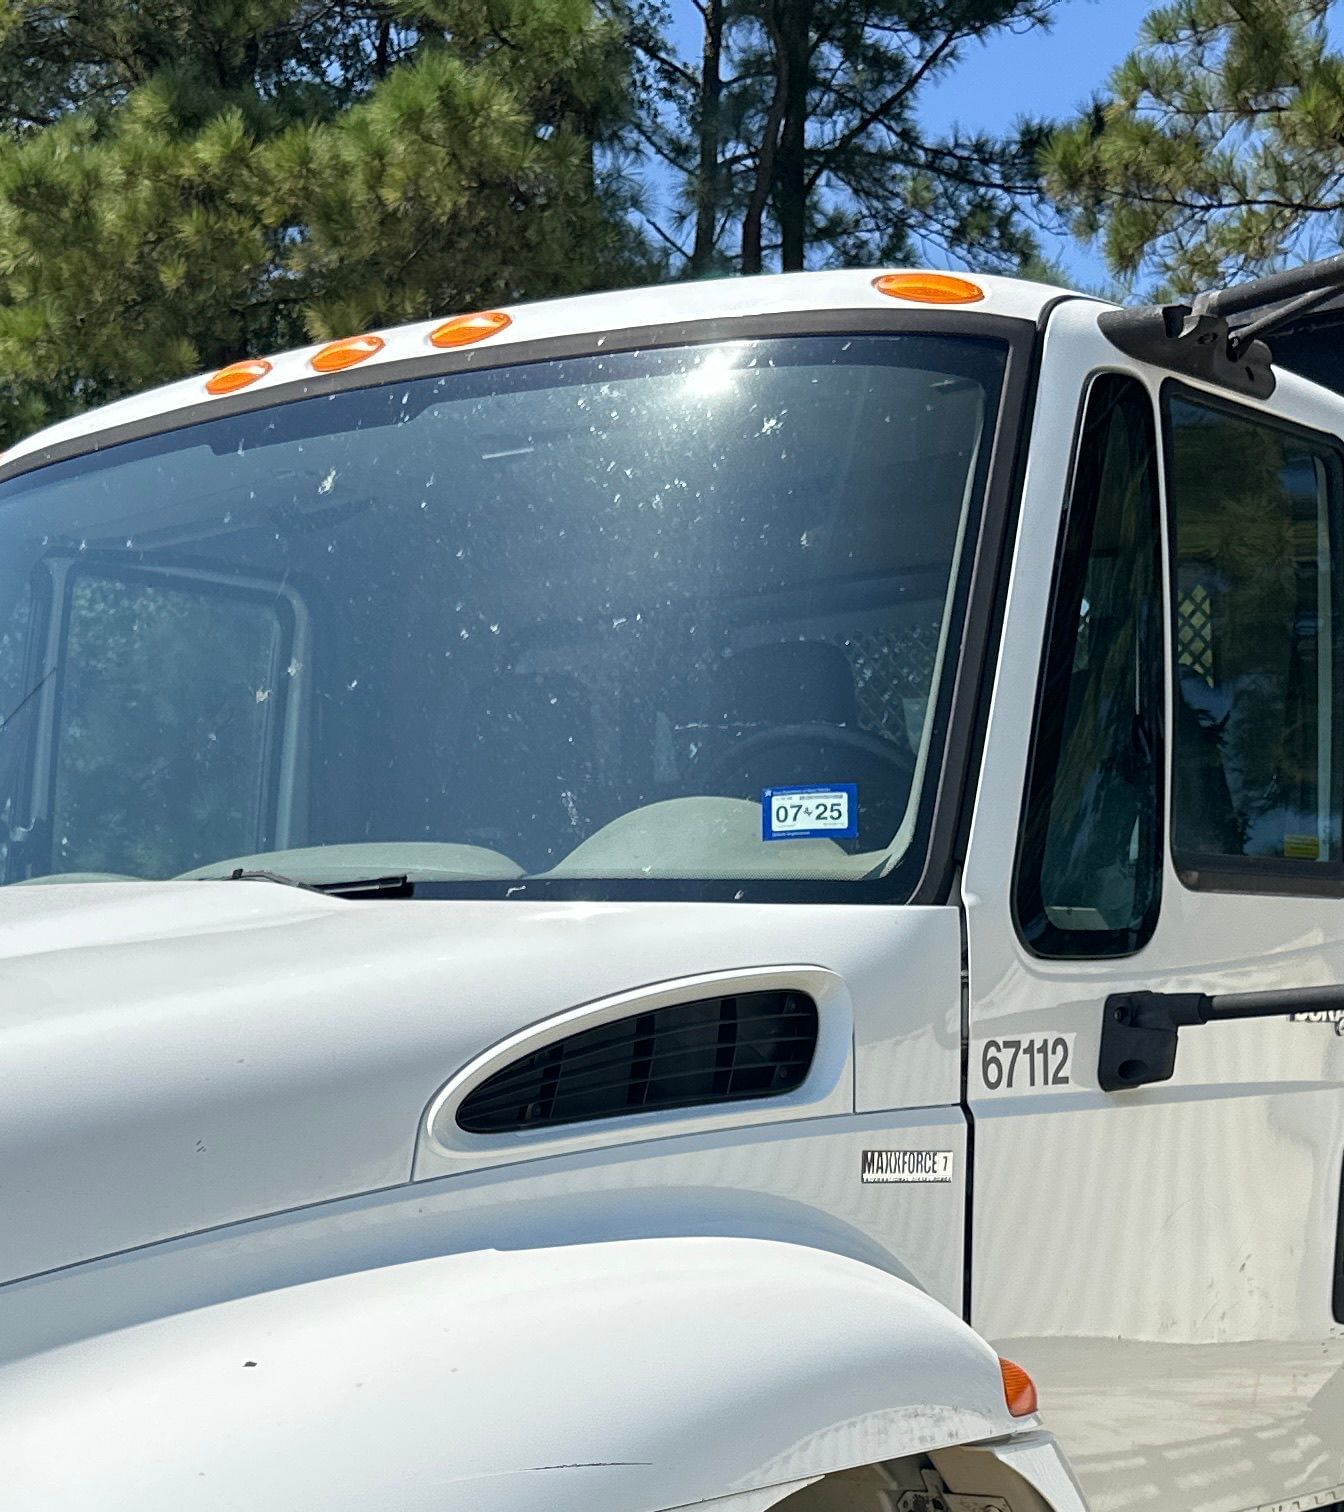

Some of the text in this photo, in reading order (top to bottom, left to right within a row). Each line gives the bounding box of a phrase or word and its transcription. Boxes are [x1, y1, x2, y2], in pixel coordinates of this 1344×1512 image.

[775, 802, 843, 823] 07 25
[981, 1037, 1070, 1091] 67112
[862, 1150, 938, 1175] MAXXFORCE
